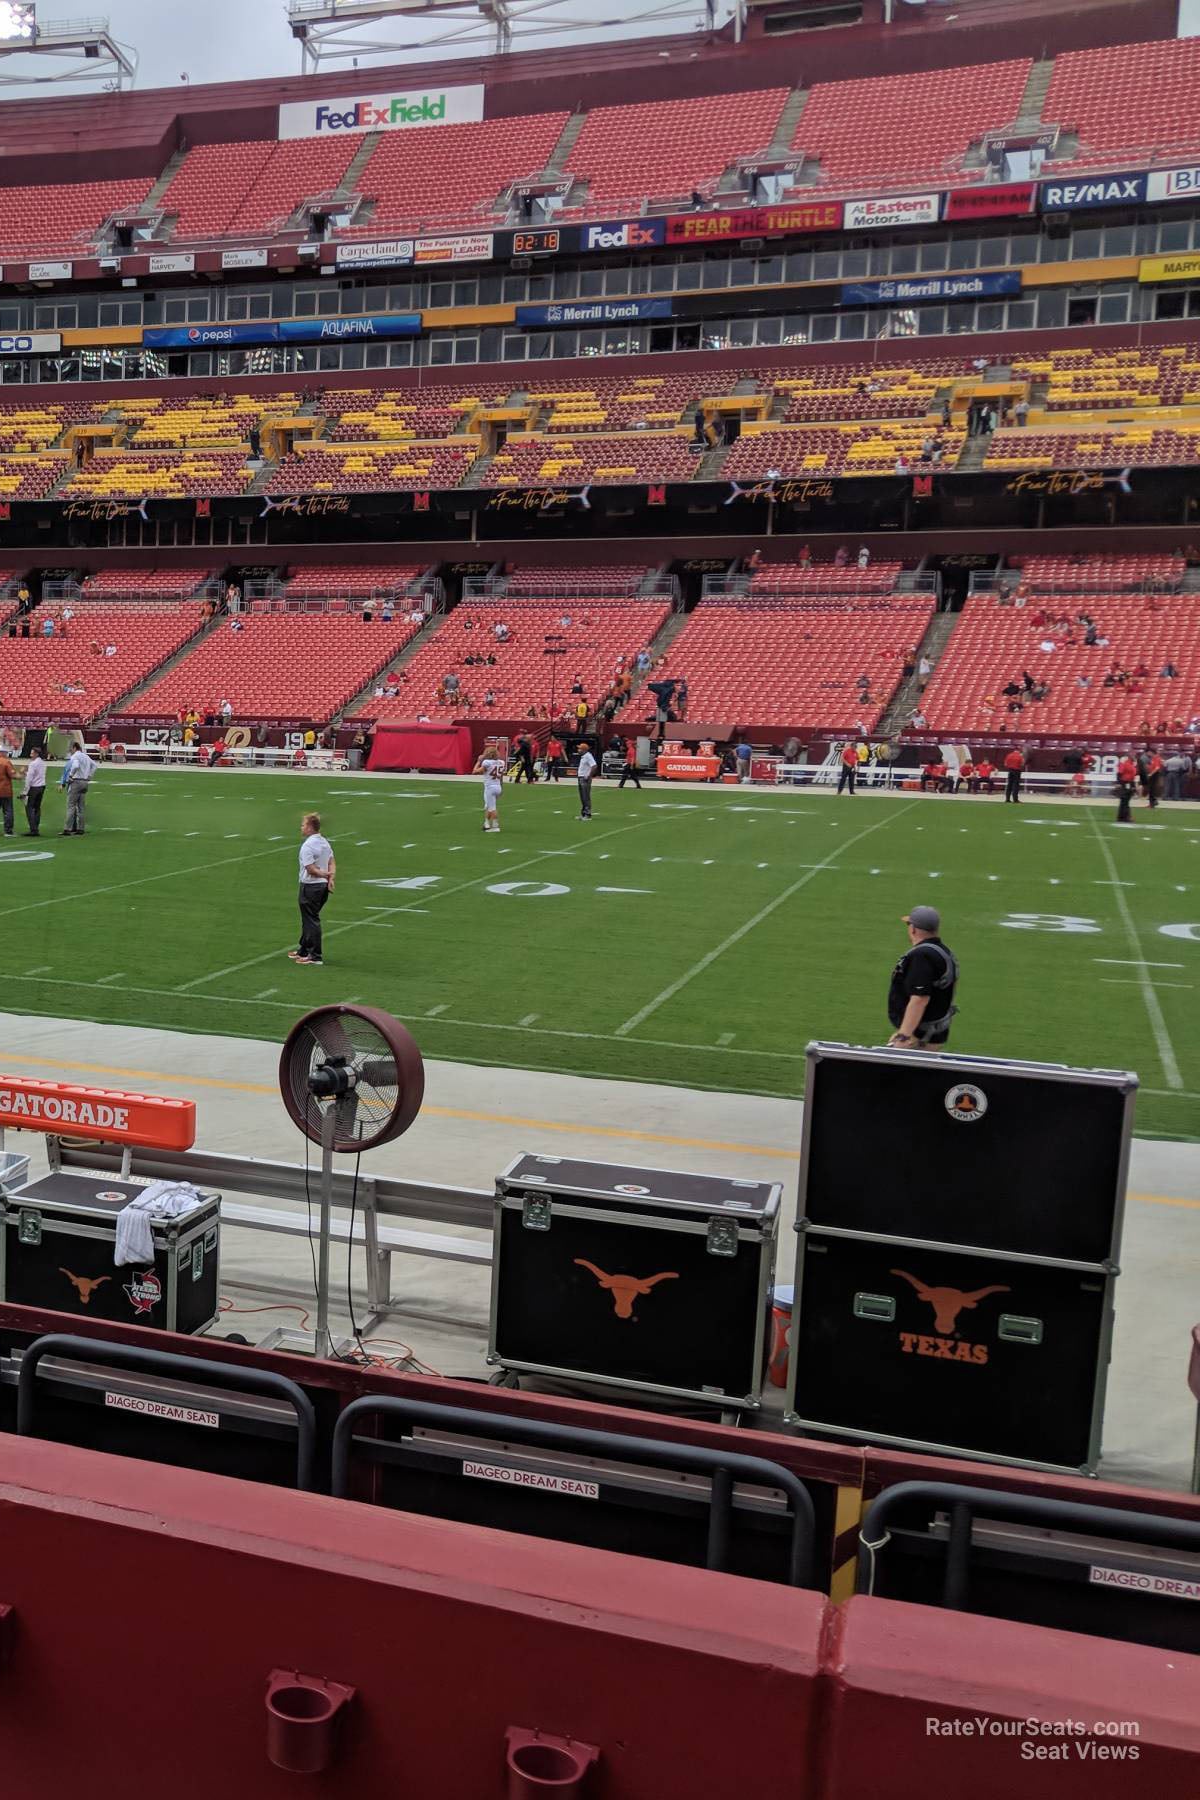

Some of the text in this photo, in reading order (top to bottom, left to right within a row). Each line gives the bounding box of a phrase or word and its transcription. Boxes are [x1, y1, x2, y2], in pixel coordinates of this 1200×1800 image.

[315, 95, 446, 131] FedExField
[1046, 180, 1138, 205] RE/MAX
[851, 199, 932, 215] At Eastern
[434, 239, 460, 247] Future
[588, 223, 656, 249] FedEx
[340, 242, 400, 260] Carpetland
[417, 249, 450, 259] Support
[453, 245, 489, 254] LEARN
[1163, 262, 1200, 274] MARY
[897, 278, 983, 297] Merrill Lynch
[564, 304, 639, 320] Merrill Lynch
[202, 328, 232, 342] pepsi
[320, 320, 374, 337] AQUAFINA
[666, 764, 707, 772] GATORADE
[899, 1332, 989, 1365] TEXAS
[106, 1394, 217, 1425] DIAGEO DREAM SEATS
[464, 1463, 597, 1496] DIAGEO DREAM SEATS
[1092, 1568, 1151, 1588] DIAGEO
